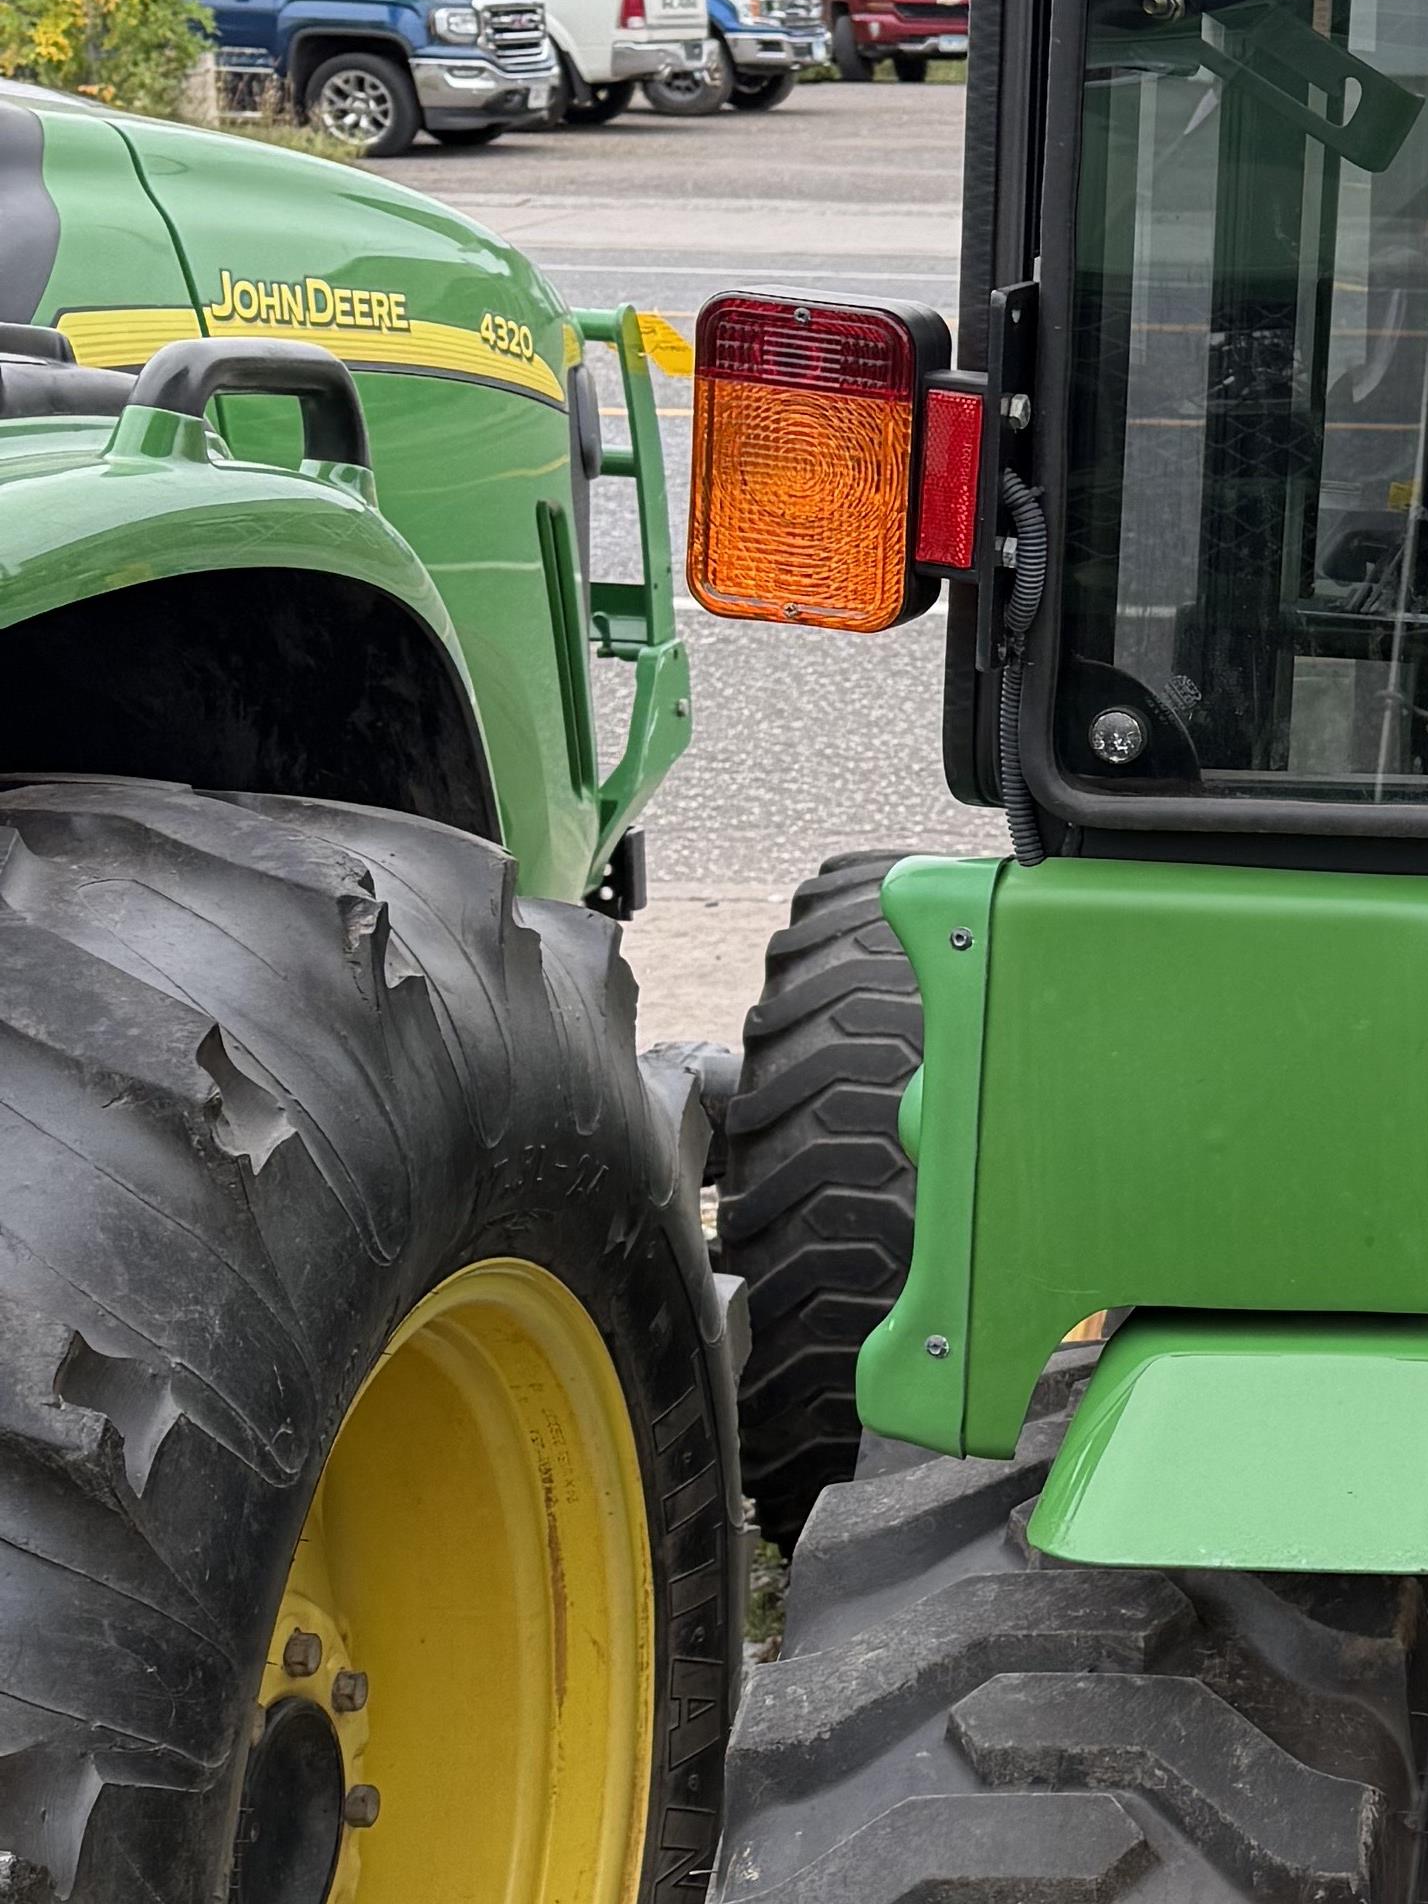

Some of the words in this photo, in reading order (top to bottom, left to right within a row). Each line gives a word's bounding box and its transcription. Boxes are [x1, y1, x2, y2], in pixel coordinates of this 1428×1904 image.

[211, 270, 304, 323] JOHN
[304, 277, 411, 331] DEERE
[479, 312, 534, 361] 4320
